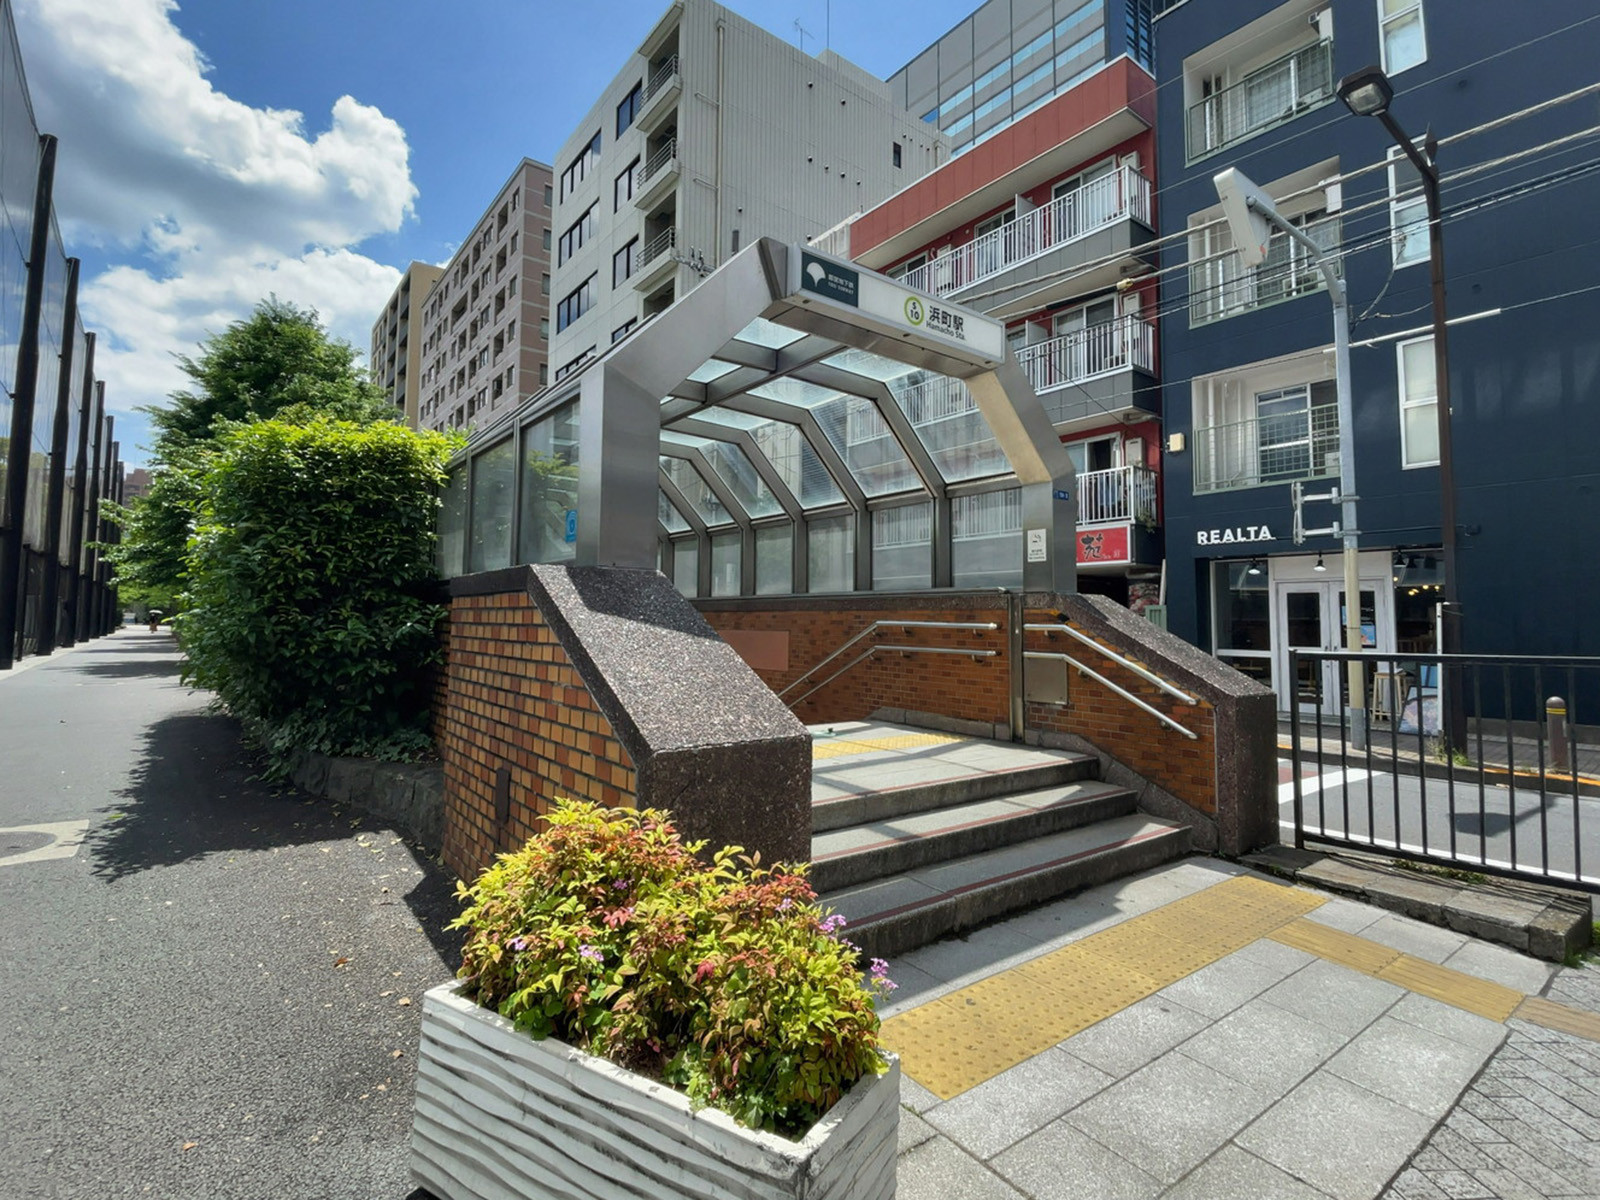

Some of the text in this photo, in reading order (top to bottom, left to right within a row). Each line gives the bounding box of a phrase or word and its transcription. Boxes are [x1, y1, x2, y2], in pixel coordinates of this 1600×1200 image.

[911, 301, 917, 310] S
[910, 309, 920, 320] 10
[928, 304, 964, 333] 浜町駅
[926, 320, 955, 337] Hamacho
[1197, 525, 1273, 545] REALTA
